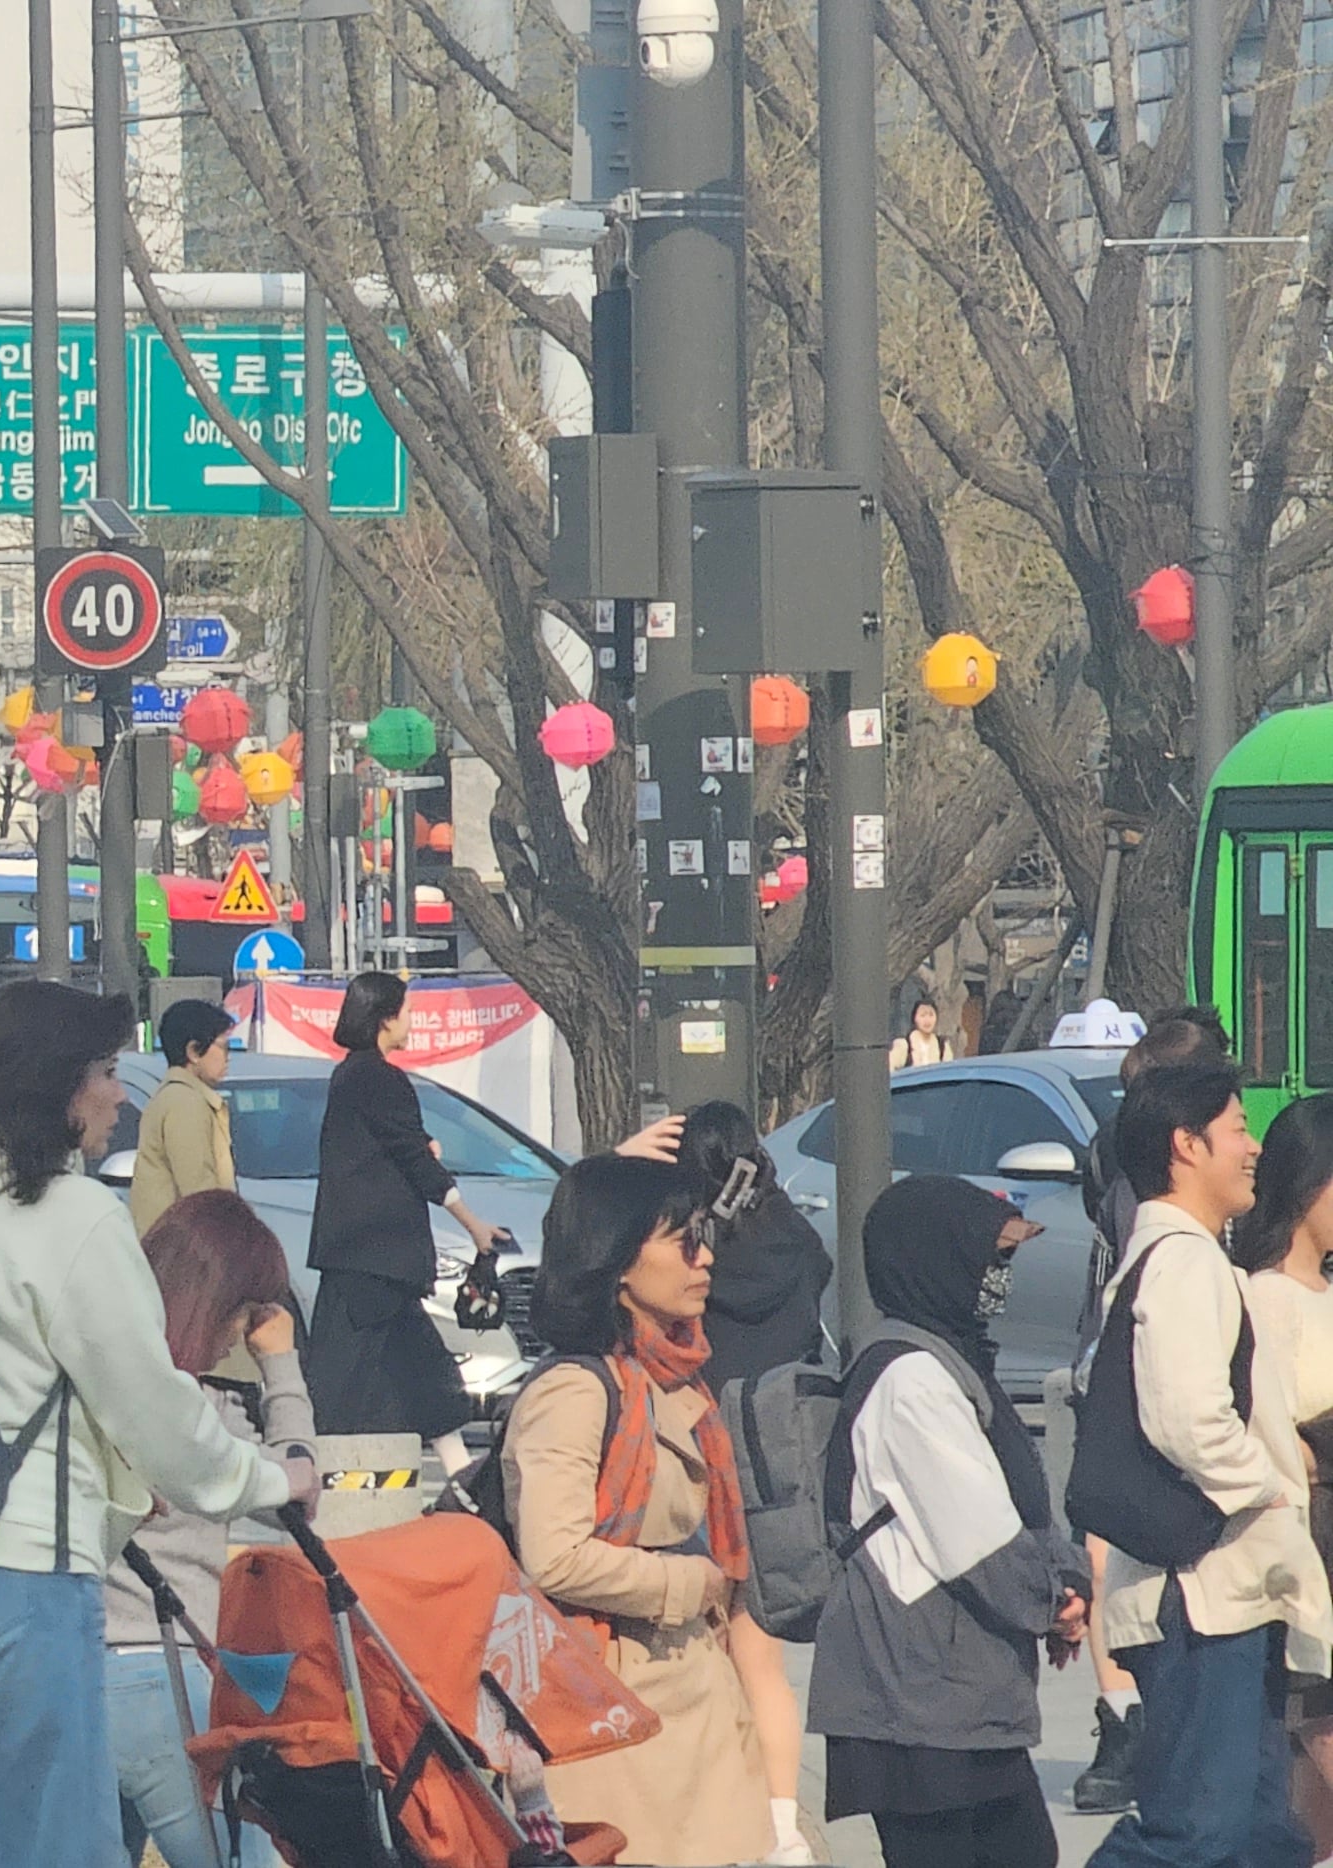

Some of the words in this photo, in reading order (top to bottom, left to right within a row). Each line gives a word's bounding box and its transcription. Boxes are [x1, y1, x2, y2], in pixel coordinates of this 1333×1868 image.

[72, 584, 134, 636] 40
[132, 709, 183, 721] amcheo
[411, 1010, 442, 1029] 비스
